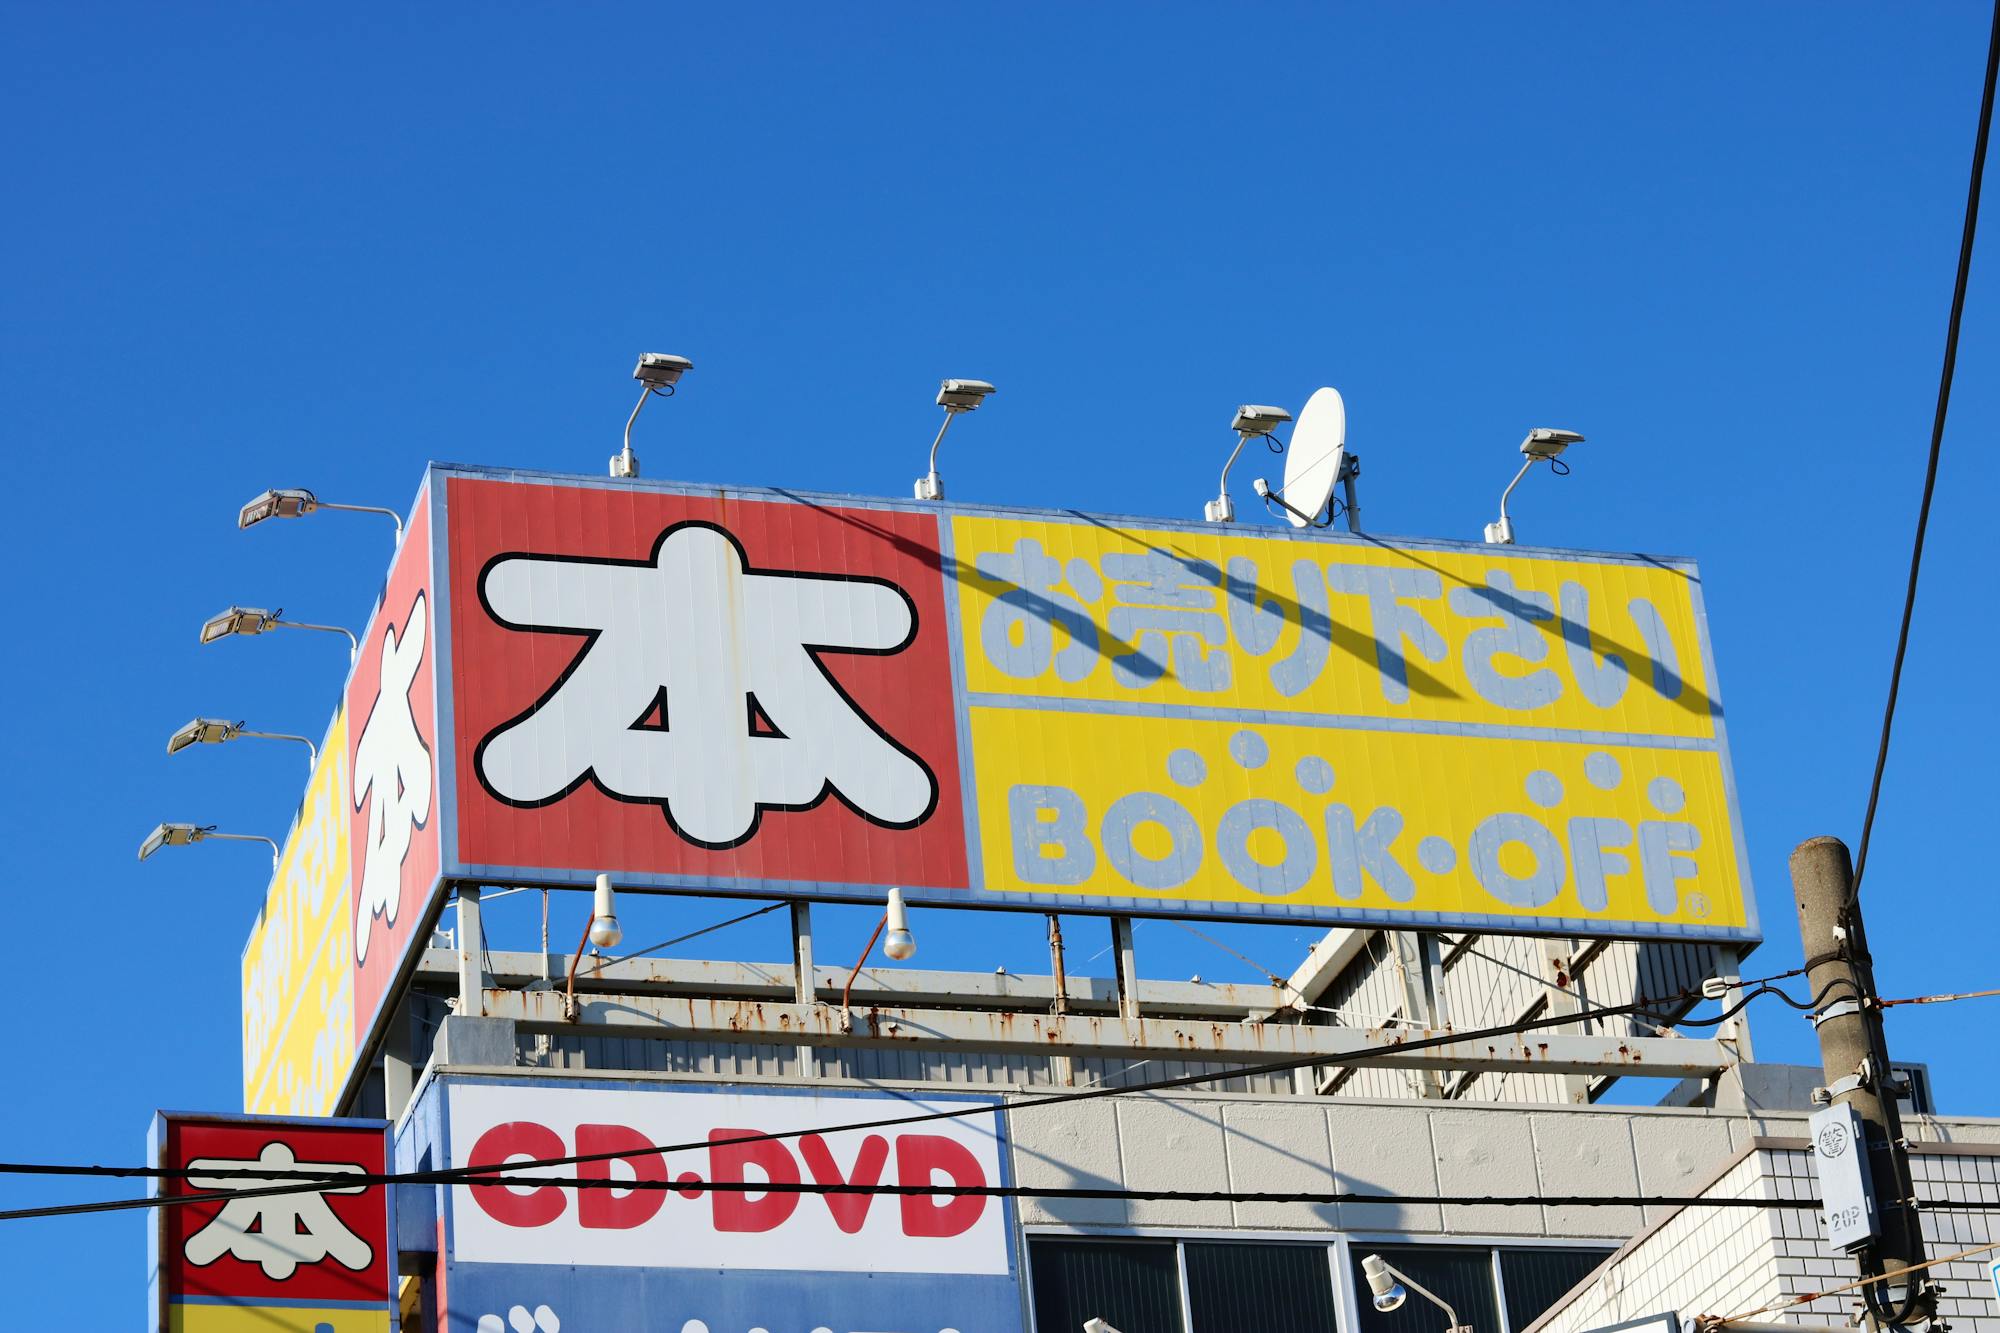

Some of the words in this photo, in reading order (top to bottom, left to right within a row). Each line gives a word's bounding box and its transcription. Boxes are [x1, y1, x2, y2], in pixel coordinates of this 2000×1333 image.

[475, 521, 939, 849] 本
[975, 536, 1682, 712] お売り下さい
[184, 1140, 375, 1282] 本
